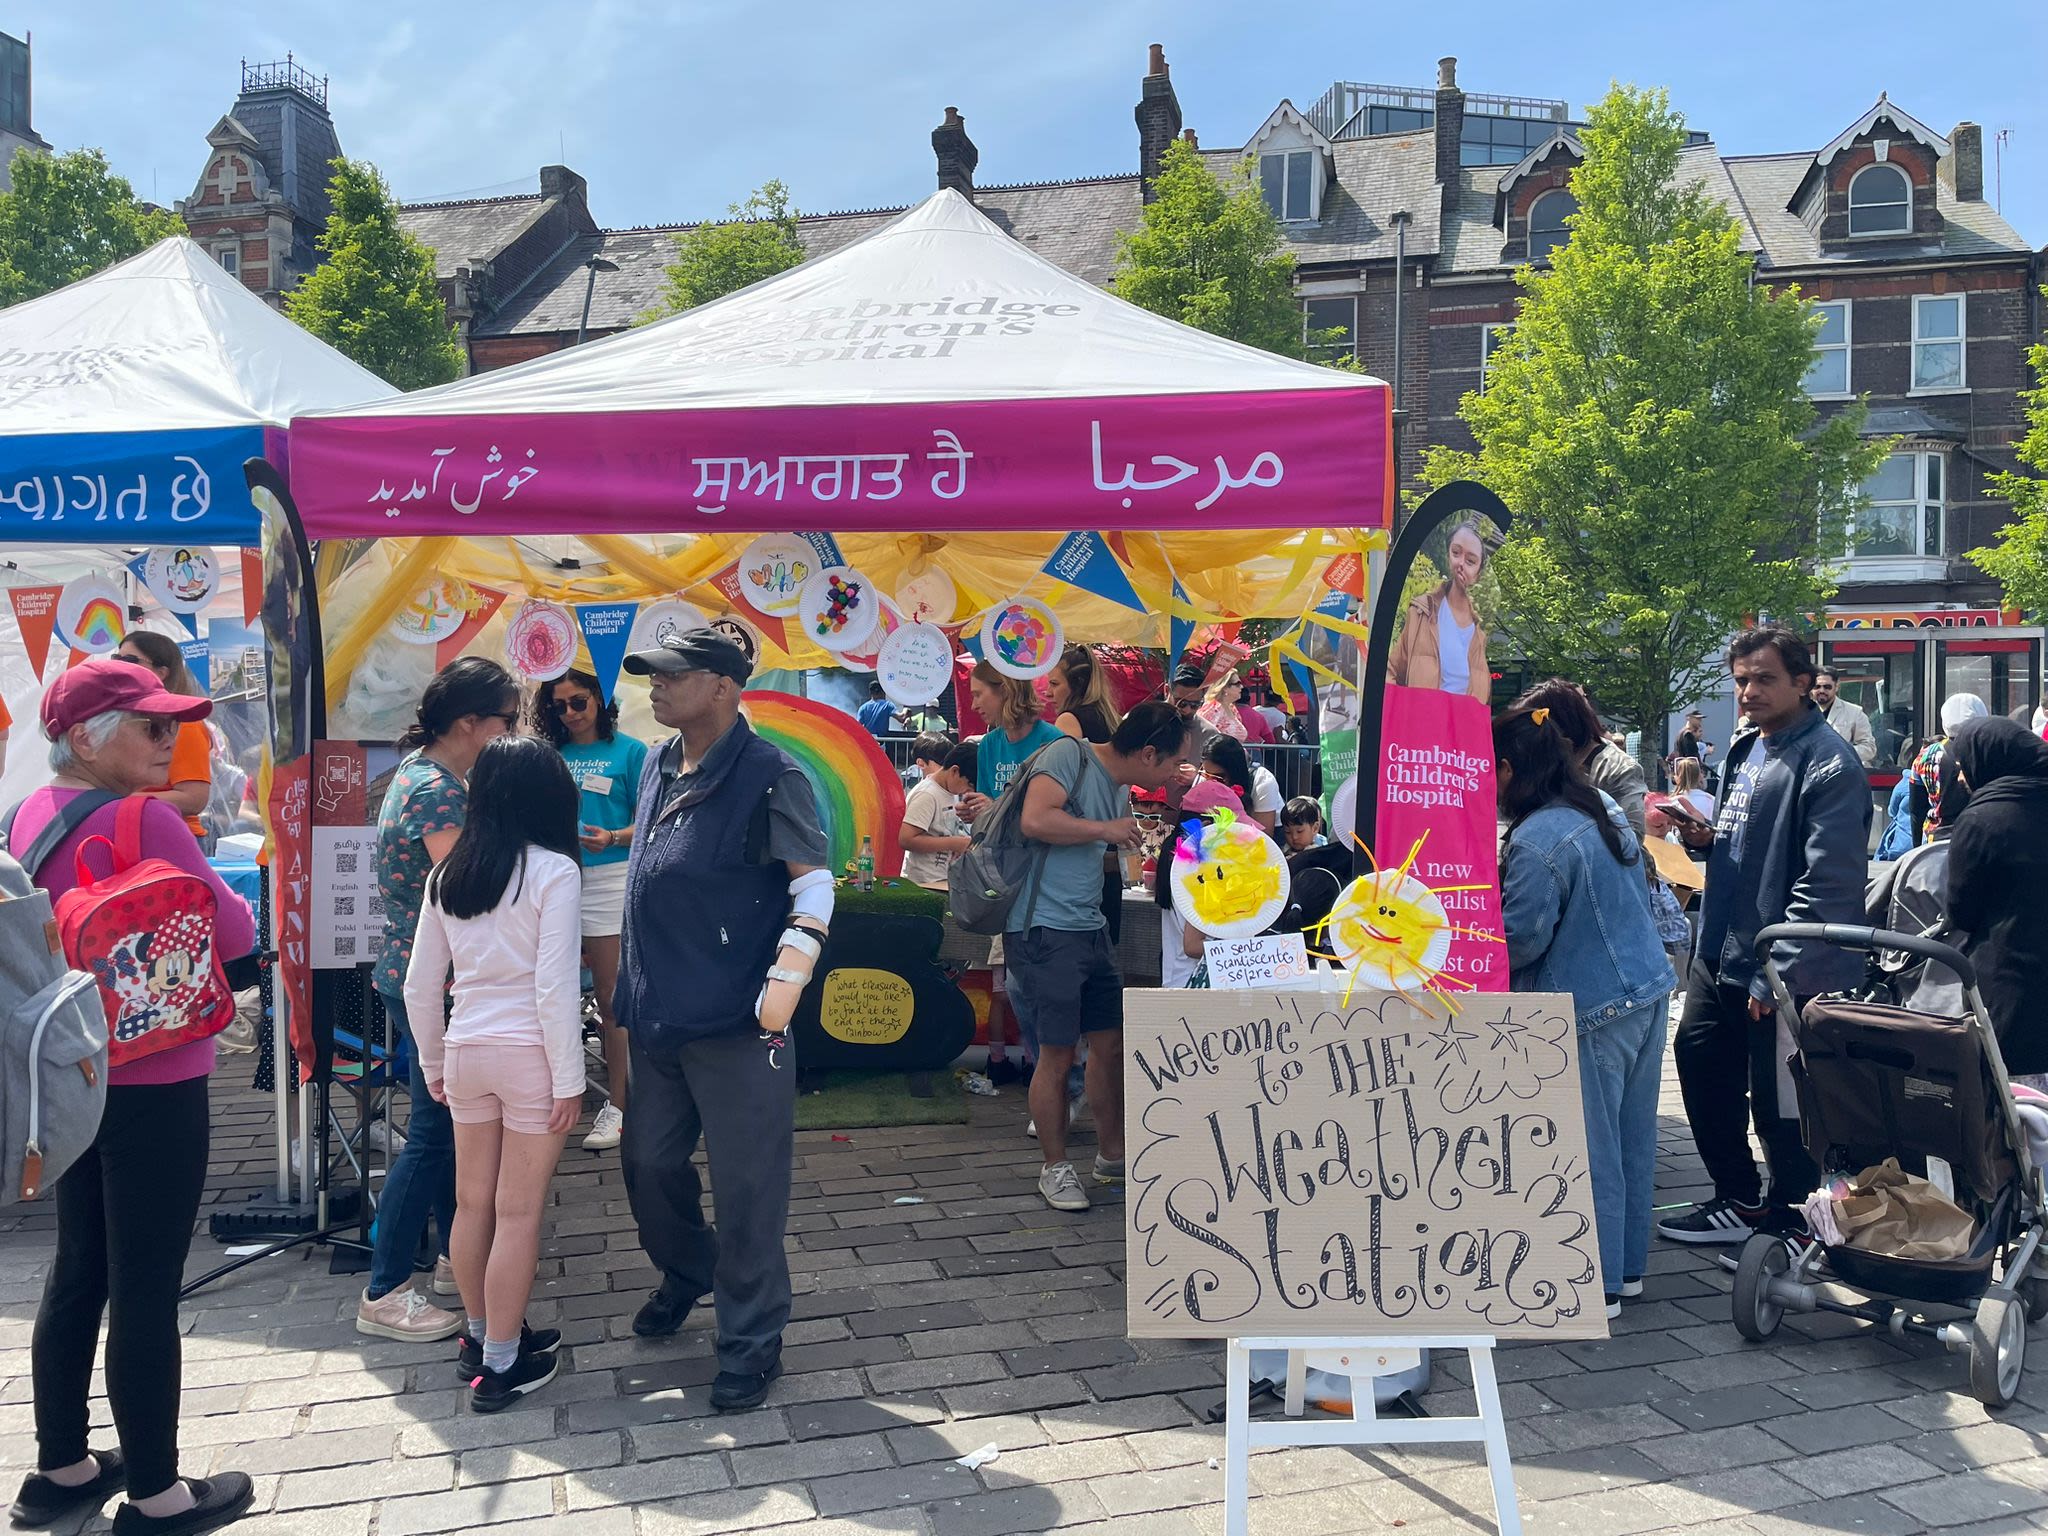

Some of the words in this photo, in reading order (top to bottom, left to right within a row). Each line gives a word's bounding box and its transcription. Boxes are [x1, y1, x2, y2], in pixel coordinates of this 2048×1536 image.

[926, 429, 974, 499] ਹੈ
[1091, 420, 1285, 511] مرحبا
[451, 444, 540, 514] خوش
[1066, 548, 1095, 581] Hospital
[16, 592, 56, 603] Cambridge
[17, 607, 47, 617] Hospital
[584, 610, 630, 619] Cambridge
[584, 618, 626, 627] Children's
[585, 626, 619, 636] Hospital
[1388, 743, 1490, 777] Cambridge
[1386, 763, 1479, 792] Children's
[1385, 784, 1465, 809] Hospital
[1427, 862, 1473, 879] new
[331, 882, 359, 892] English
[334, 923, 357, 932] Polski
[1467, 921, 1495, 942] for
[1210, 942, 1225, 957] mi
[1470, 953, 1494, 973] of
[836, 980, 858, 991] what
[862, 980, 900, 992] treasure
[833, 991, 861, 1004] would
[863, 993, 881, 1008] you
[884, 991, 901, 1002] like
[828, 1006, 839, 1016] to
[840, 1003, 862, 1019] find
[867, 1007, 879, 1016] at
[882, 1005, 898, 1016] the
[834, 1017, 852, 1026] end
[856, 1017, 866, 1028] of
[869, 1017, 886, 1025] the
[1133, 1016, 1300, 1092] Welcome
[1252, 1054, 1304, 1105] to
[1309, 1032, 1416, 1098] THE
[1204, 1088, 1557, 1211] Weather
[1165, 1178, 1557, 1323] Station
